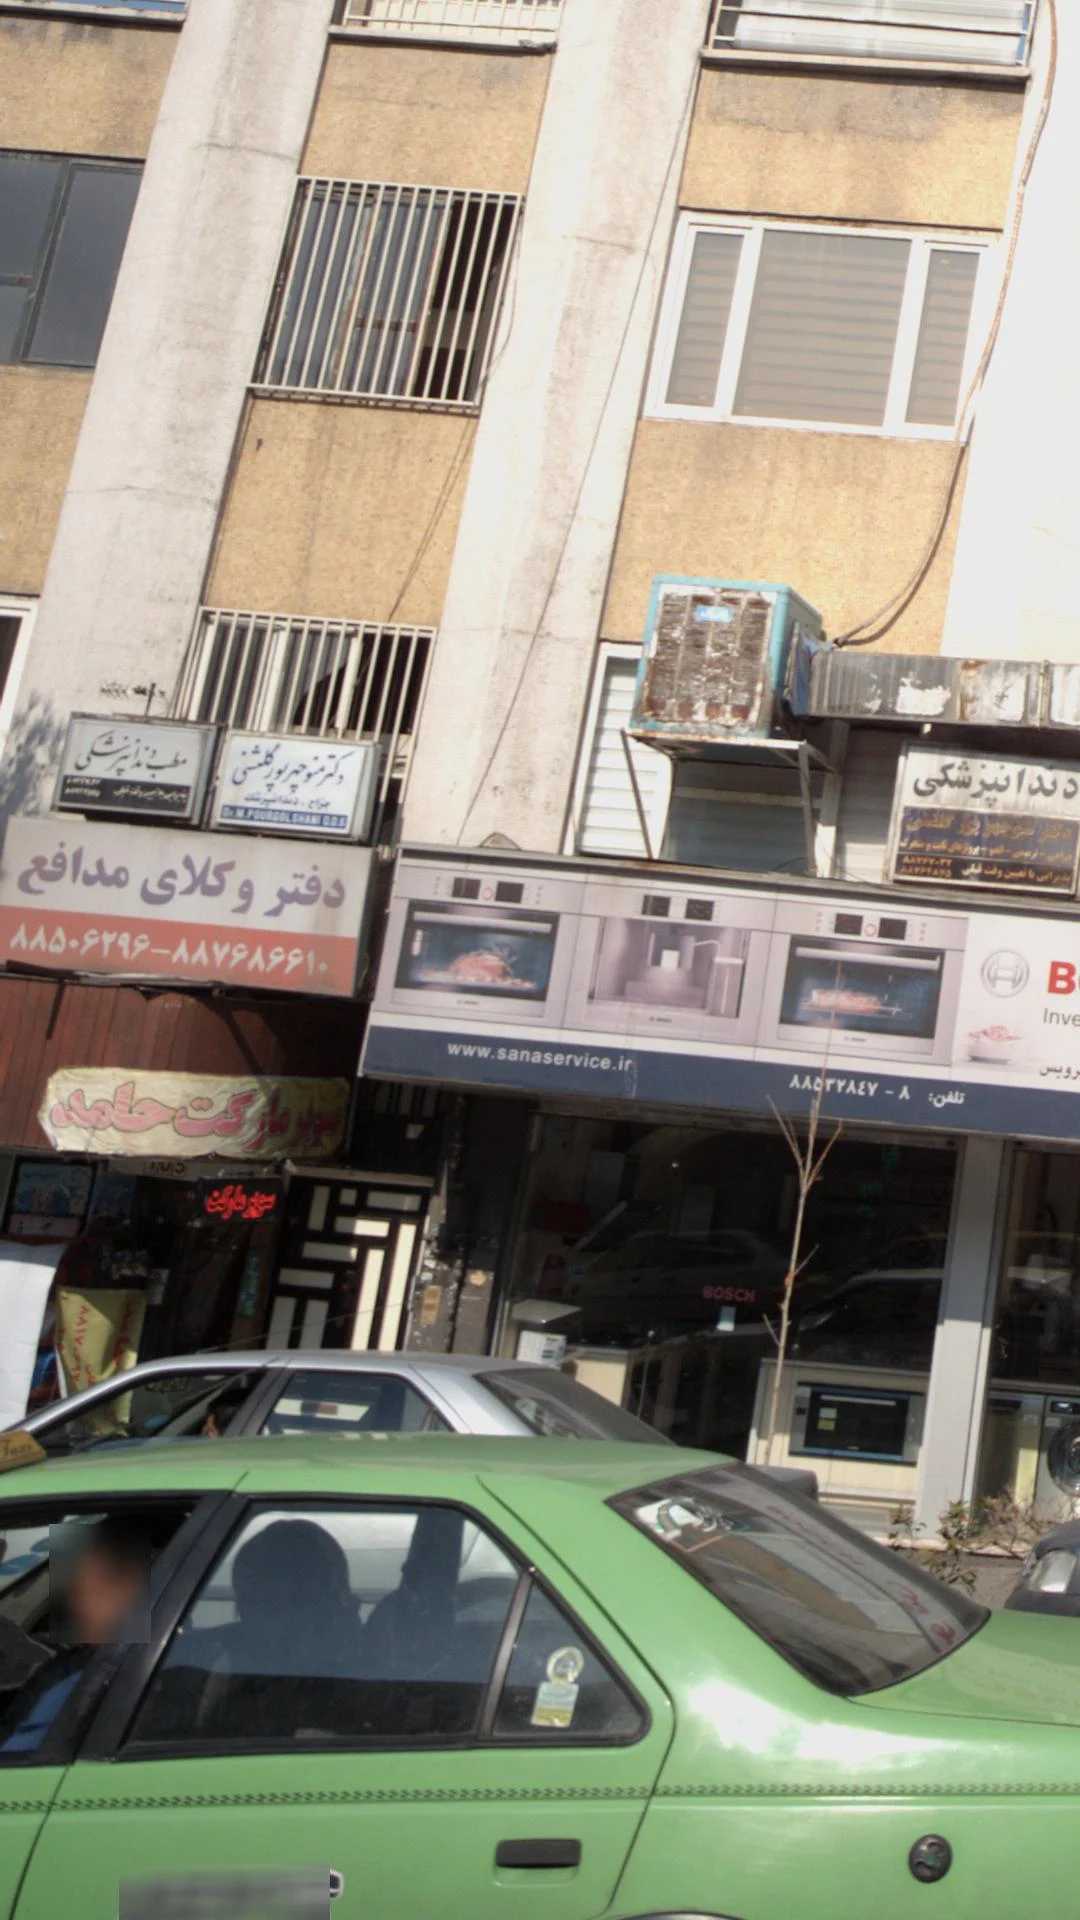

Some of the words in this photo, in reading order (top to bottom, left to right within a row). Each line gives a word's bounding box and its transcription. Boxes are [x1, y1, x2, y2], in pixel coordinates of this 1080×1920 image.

[17, 841, 130, 895] مدافع
[263, 864, 346, 917] دفتر
[1047, 960, 1080, 996] B
[447, 1041, 633, 1072] www.sanaservice.ir
[703, 1285, 757, 1302] BOSCH
